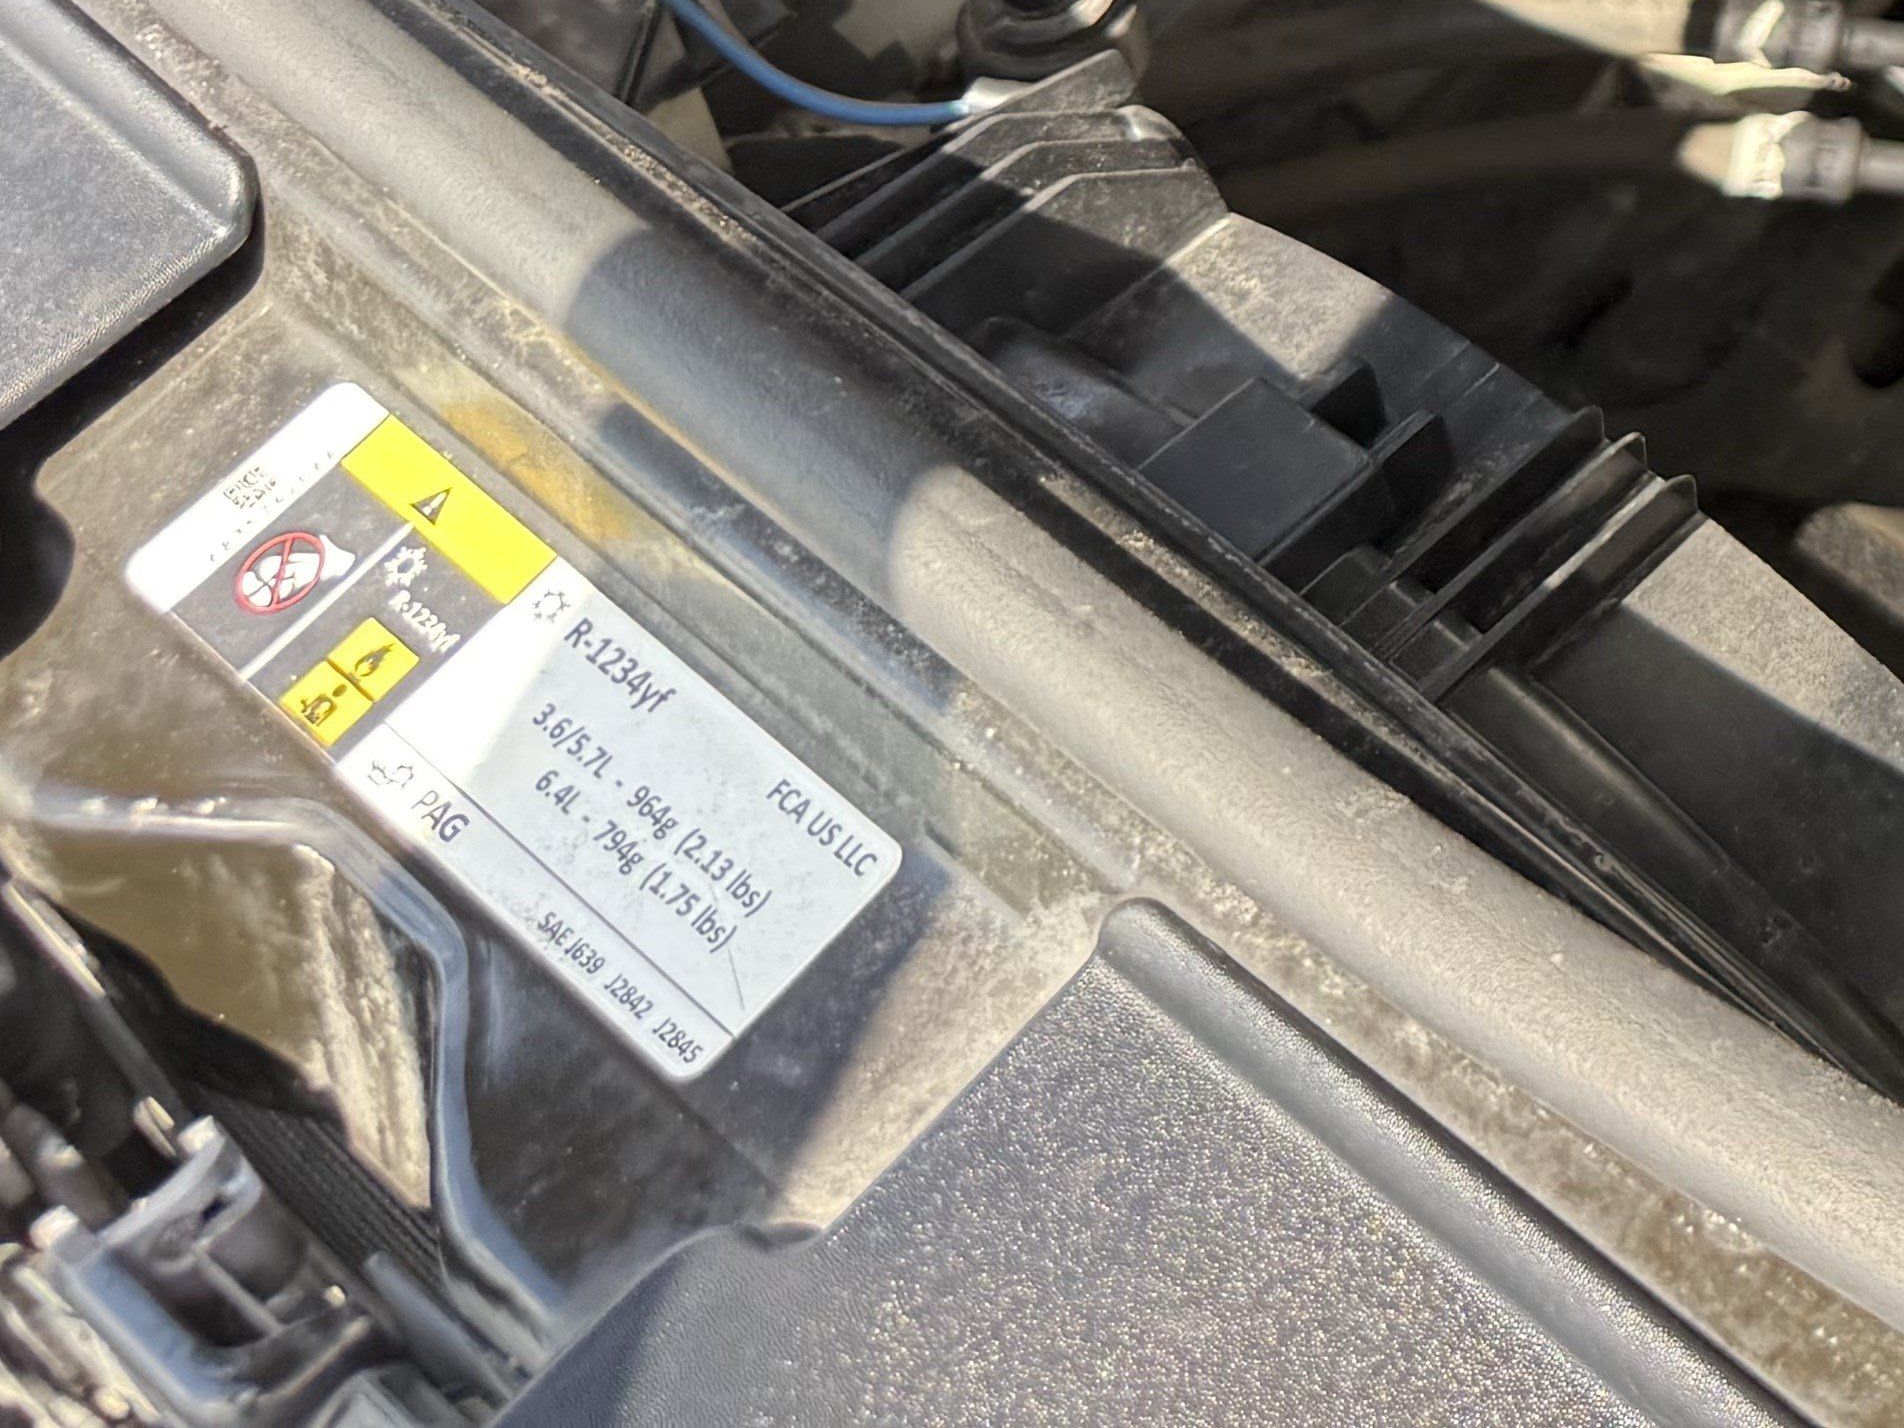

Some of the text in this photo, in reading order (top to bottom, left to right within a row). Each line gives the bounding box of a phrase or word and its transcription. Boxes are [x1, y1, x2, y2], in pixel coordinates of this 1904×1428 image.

[563, 617, 677, 713] R-1234yf
[410, 789, 470, 843] PAG
[532, 702, 613, 779] 3.6/5.7L
[626, 785, 679, 840] 964g
[673, 827, 735, 882] (2.13
[726, 868, 773, 918] lbs)
[535, 769, 581, 815] 6.4L
[592, 819, 645, 876] 794g
[639, 862, 701, 917] (1.75
[691, 904, 738, 954] lbs)
[766, 778, 877, 877] FCA US LLC
[537, 911, 704, 1064] SAE J639 J2842 J2845
